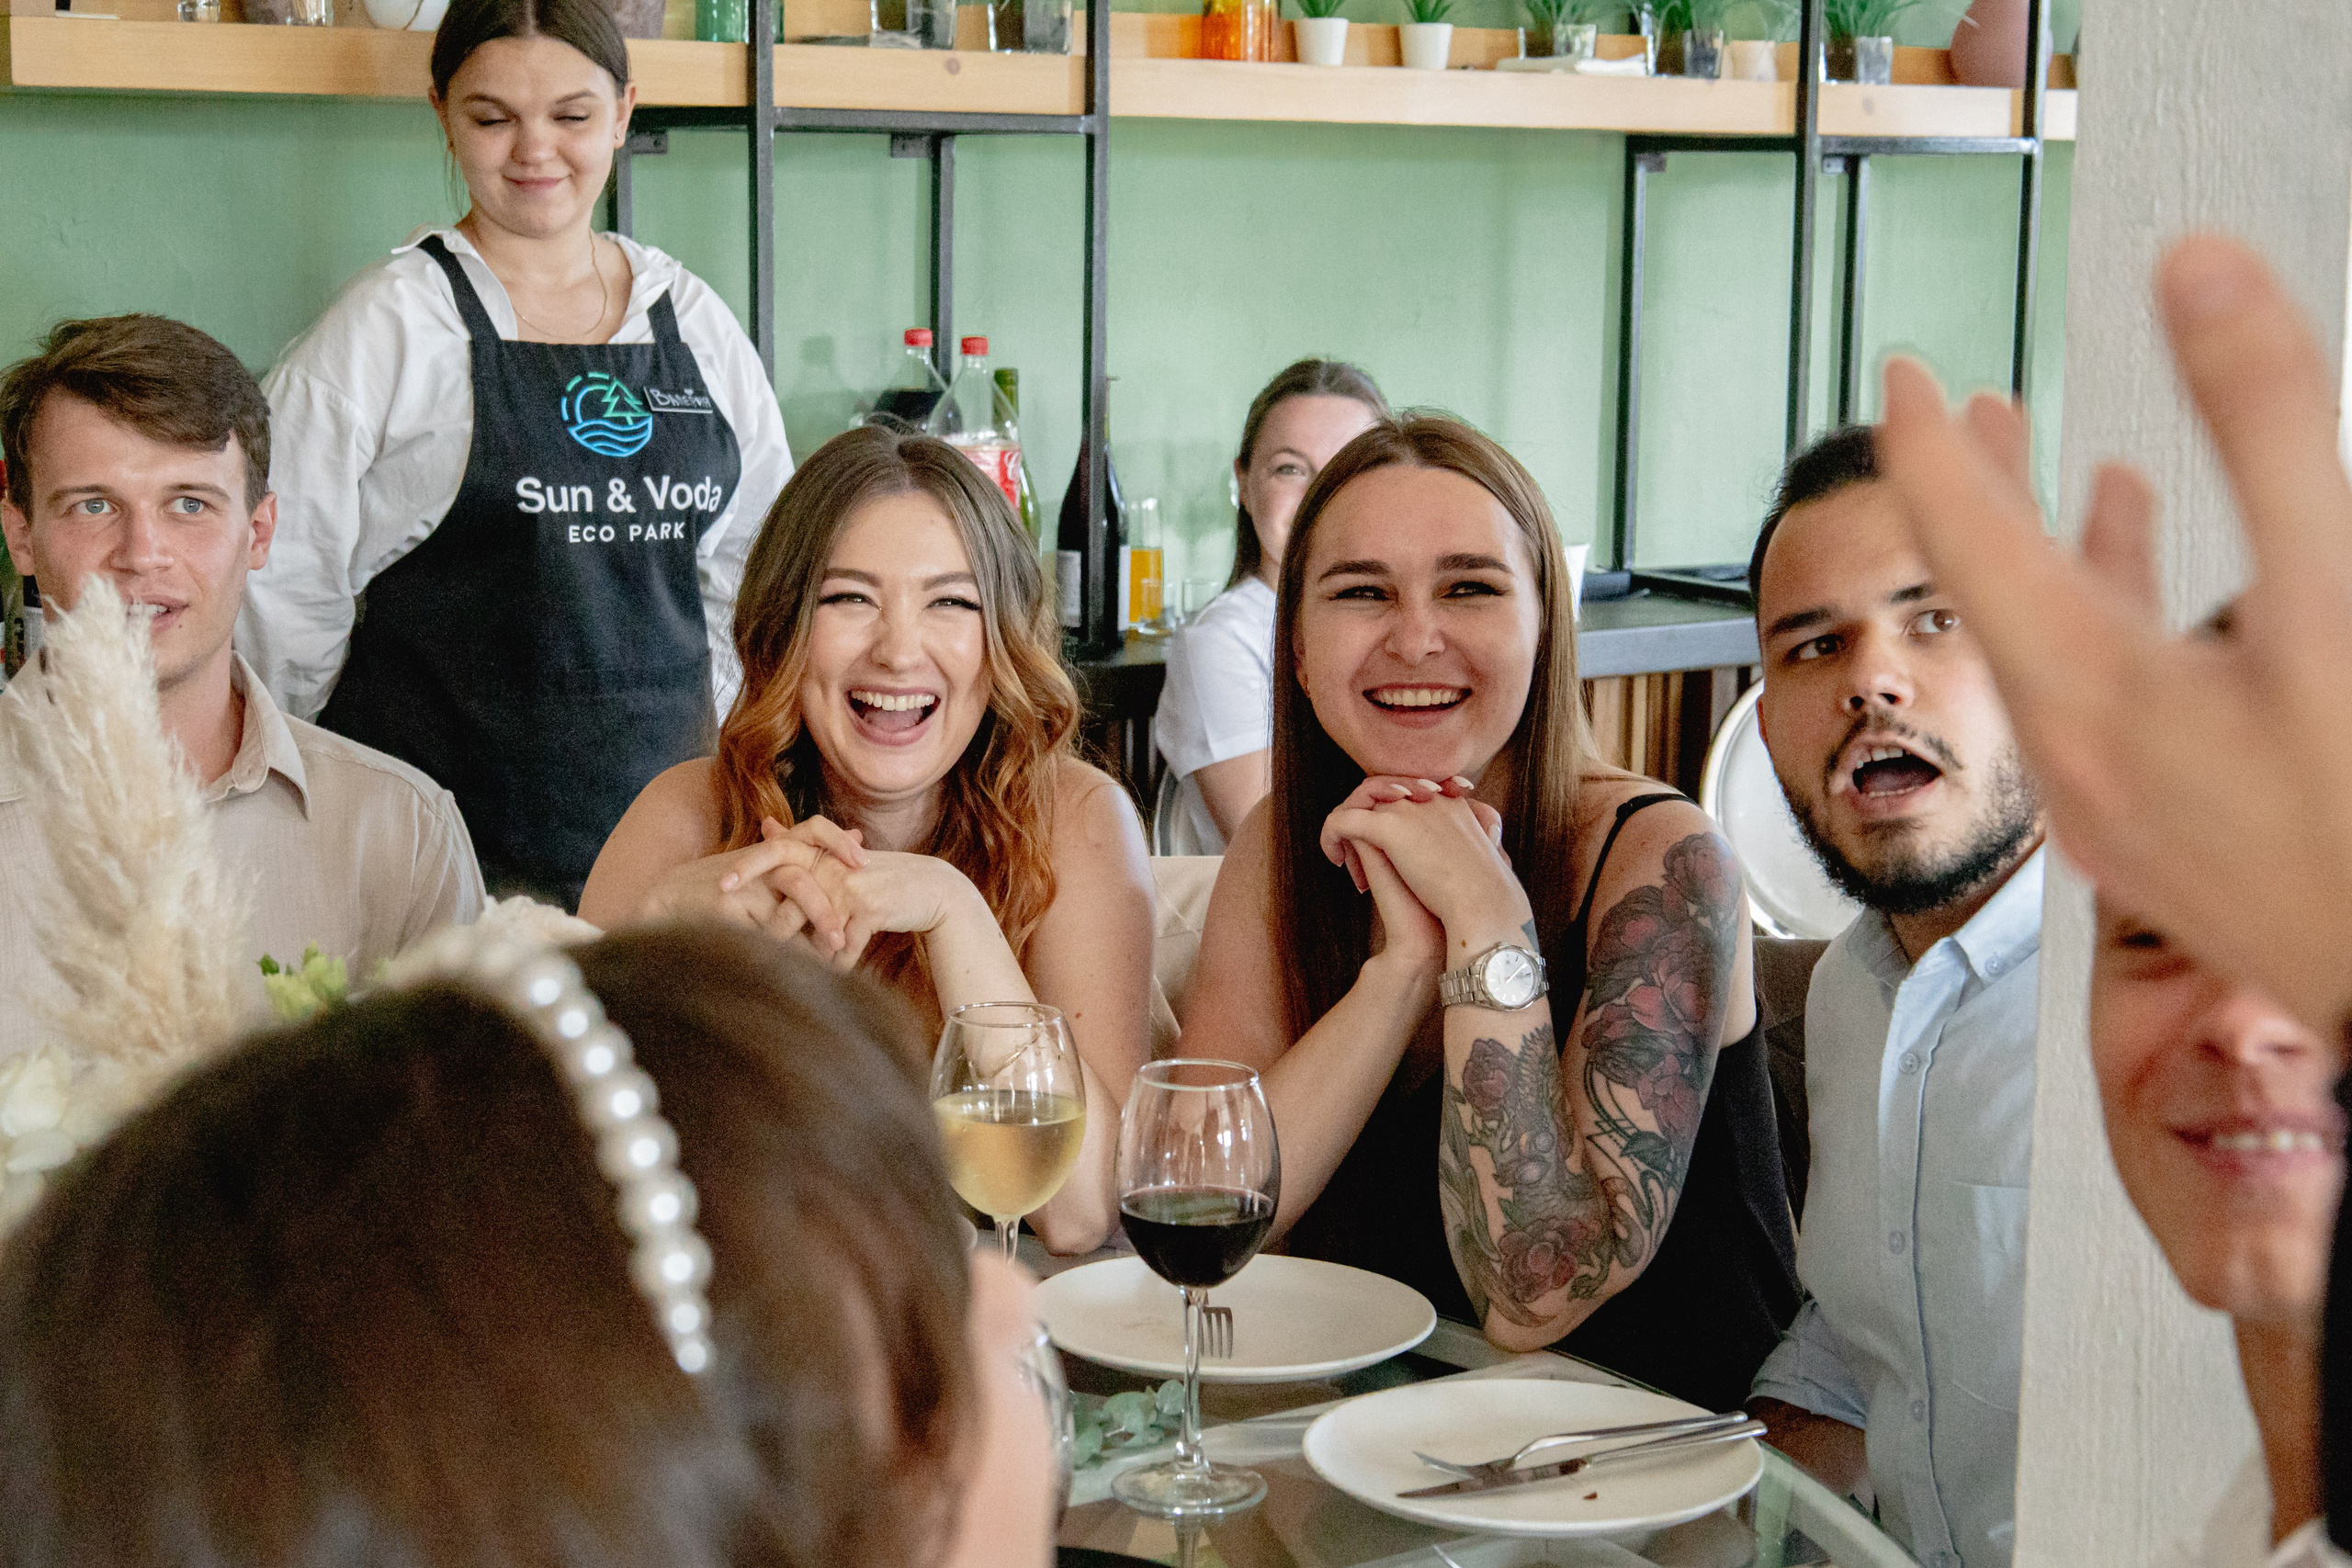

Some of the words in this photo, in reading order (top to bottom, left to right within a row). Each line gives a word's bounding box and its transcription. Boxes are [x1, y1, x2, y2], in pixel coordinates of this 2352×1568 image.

[515, 476, 594, 513] Sun
[606, 477, 637, 513] &
[643, 475, 722, 513] Voda
[568, 525, 616, 544] ECO
[628, 521, 685, 542] PARK
